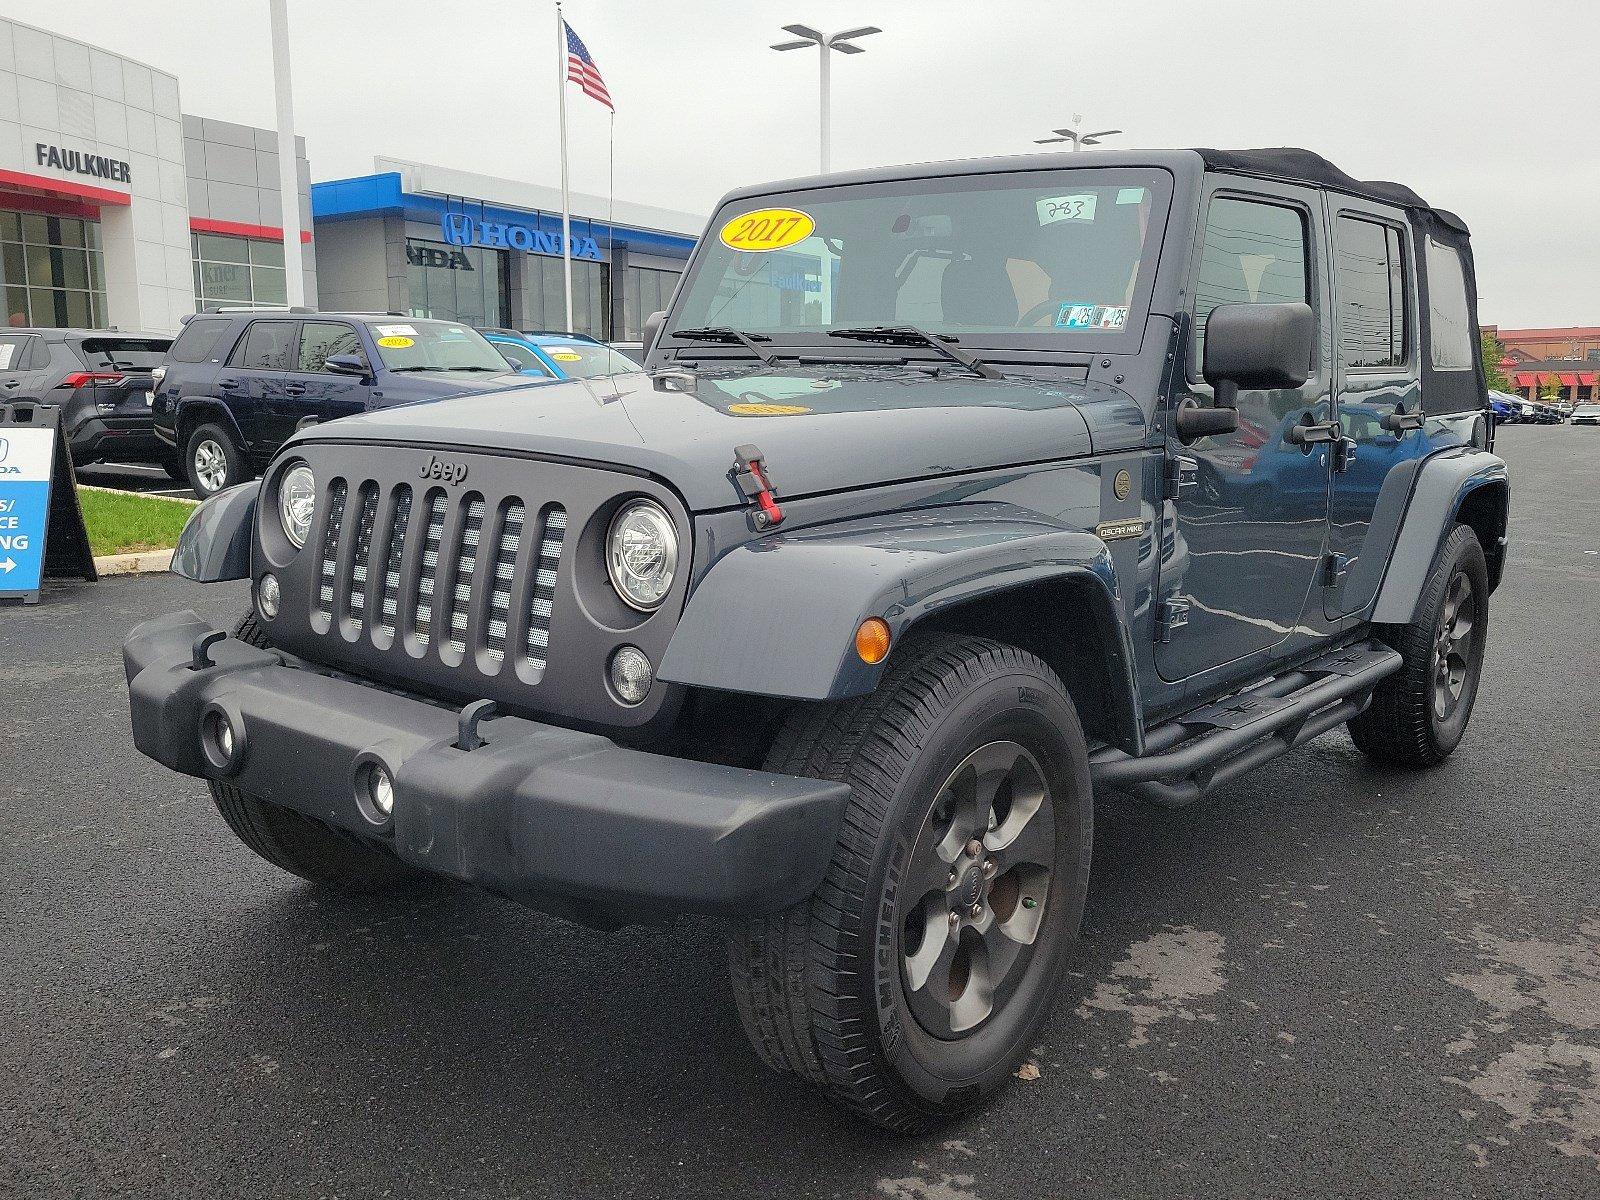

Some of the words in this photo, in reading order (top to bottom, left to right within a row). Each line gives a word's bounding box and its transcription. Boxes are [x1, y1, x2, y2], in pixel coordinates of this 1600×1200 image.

[36, 143, 131, 183] FAULKNER
[479, 221, 604, 260] HONDA
[730, 217, 802, 242] 2017
[419, 455, 468, 486] Jeep
[0, 535, 29, 550] NG
[1101, 527, 1126, 537] OSCAR
[1126, 524, 1143, 534] MIKE
